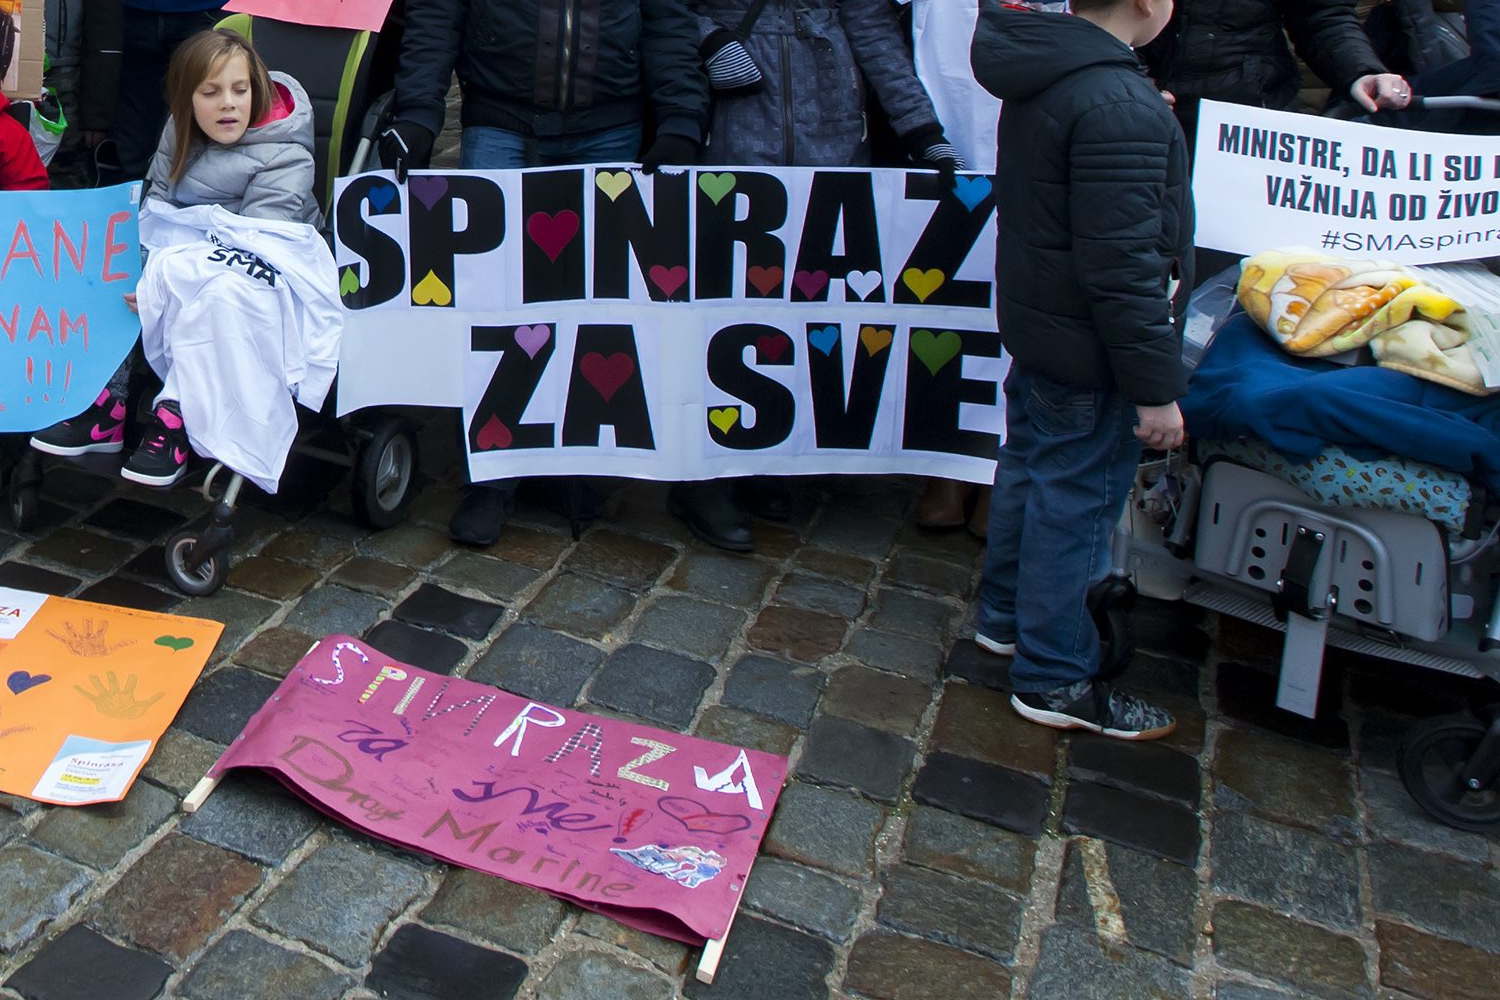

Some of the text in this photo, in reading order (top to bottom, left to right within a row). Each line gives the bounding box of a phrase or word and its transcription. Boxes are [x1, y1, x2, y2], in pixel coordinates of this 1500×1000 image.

[1218, 123, 1350, 178] MINISTRE,
[1361, 146, 1397, 179] DA
[1409, 152, 1432, 181] LI
[1444, 154, 1482, 182] SU
[1266, 174, 1500, 221] VAŽNIJA OD ŽIVO
[207, 248, 276, 288] SMA
[469, 321, 1000, 461] ZA SVE
[312, 642, 764, 810] SPINRAZA
[337, 719, 409, 762] za
[422, 810, 636, 898] Marine
